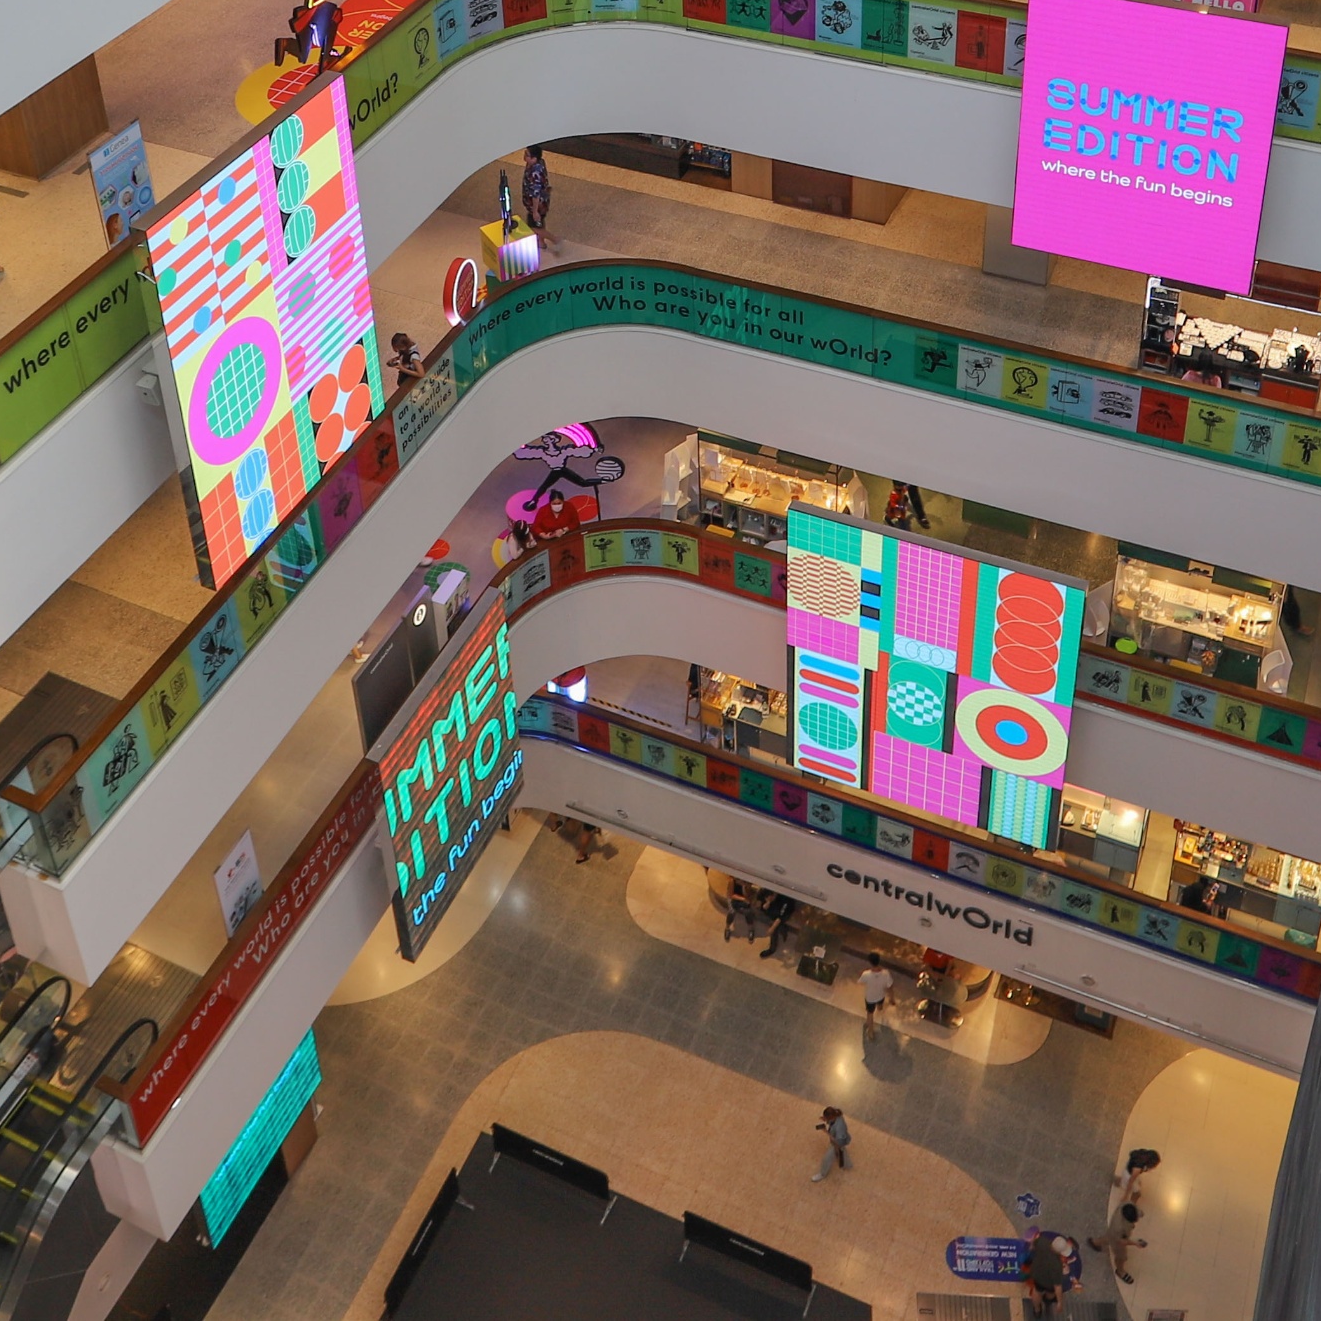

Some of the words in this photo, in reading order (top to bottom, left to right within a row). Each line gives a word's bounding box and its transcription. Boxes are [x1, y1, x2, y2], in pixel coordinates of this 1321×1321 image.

[1045, 78, 1244, 143] SUMMER
[1041, 159, 1097, 182] where
[1099, 168, 1131, 188] the
[1135, 175, 1166, 196] fun
[1170, 182, 1233, 208] begins
[1043, 118, 1239, 184] EDITION
[75, 280, 131, 334] every
[468, 308, 511, 348] where
[514, 285, 565, 316] every
[569, 275, 625, 296] world
[629, 276, 646, 293] is
[653, 278, 738, 311] possible
[743, 297, 772, 318] for
[778, 305, 805, 326] all
[592, 294, 647, 313] Who
[653, 299, 690, 319] are
[696, 310, 737, 333] you
[744, 315, 763, 335] in
[769, 326, 805, 347] our
[811, 335, 893, 368] wOrld?
[3, 326, 71, 395] where
[350, 782, 372, 808] for
[252, 912, 291, 965] Who
[294, 870, 319, 909] are
[322, 829, 350, 872] you
[412, 871, 448, 926] the
[448, 819, 481, 873] fun
[826, 862, 1034, 948] centralwOrld
[139, 1032, 189, 1104] where
[191, 972, 230, 1031] every
[233, 911, 274, 971] world
[275, 894, 288, 915] is
[291, 810, 349, 893] possible
